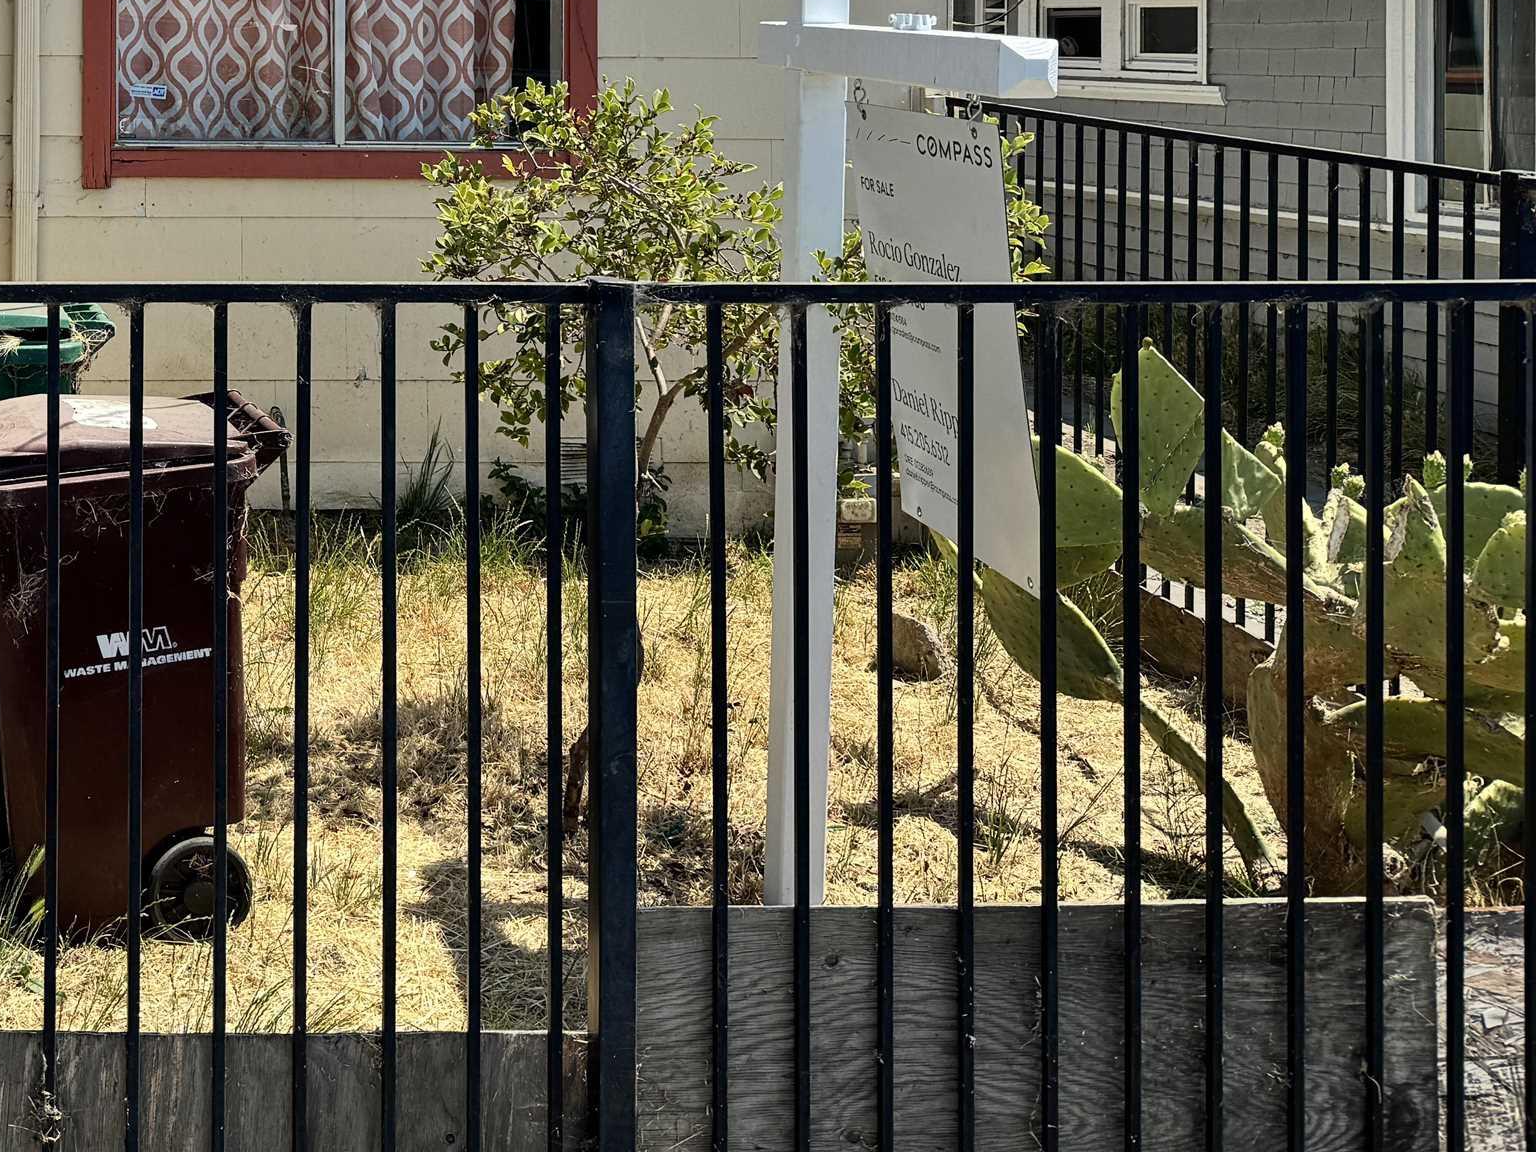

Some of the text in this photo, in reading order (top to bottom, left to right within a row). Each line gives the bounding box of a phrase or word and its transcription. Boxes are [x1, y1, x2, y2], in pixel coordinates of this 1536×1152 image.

[915, 133, 993, 169] COMPASS
[860, 176, 895, 198] FOR SALE
[868, 230, 962, 283] Rocio Gonzalez
[891, 378, 930, 418] Daniel
[64, 648, 213, 679] WASTE MAGEMENT
